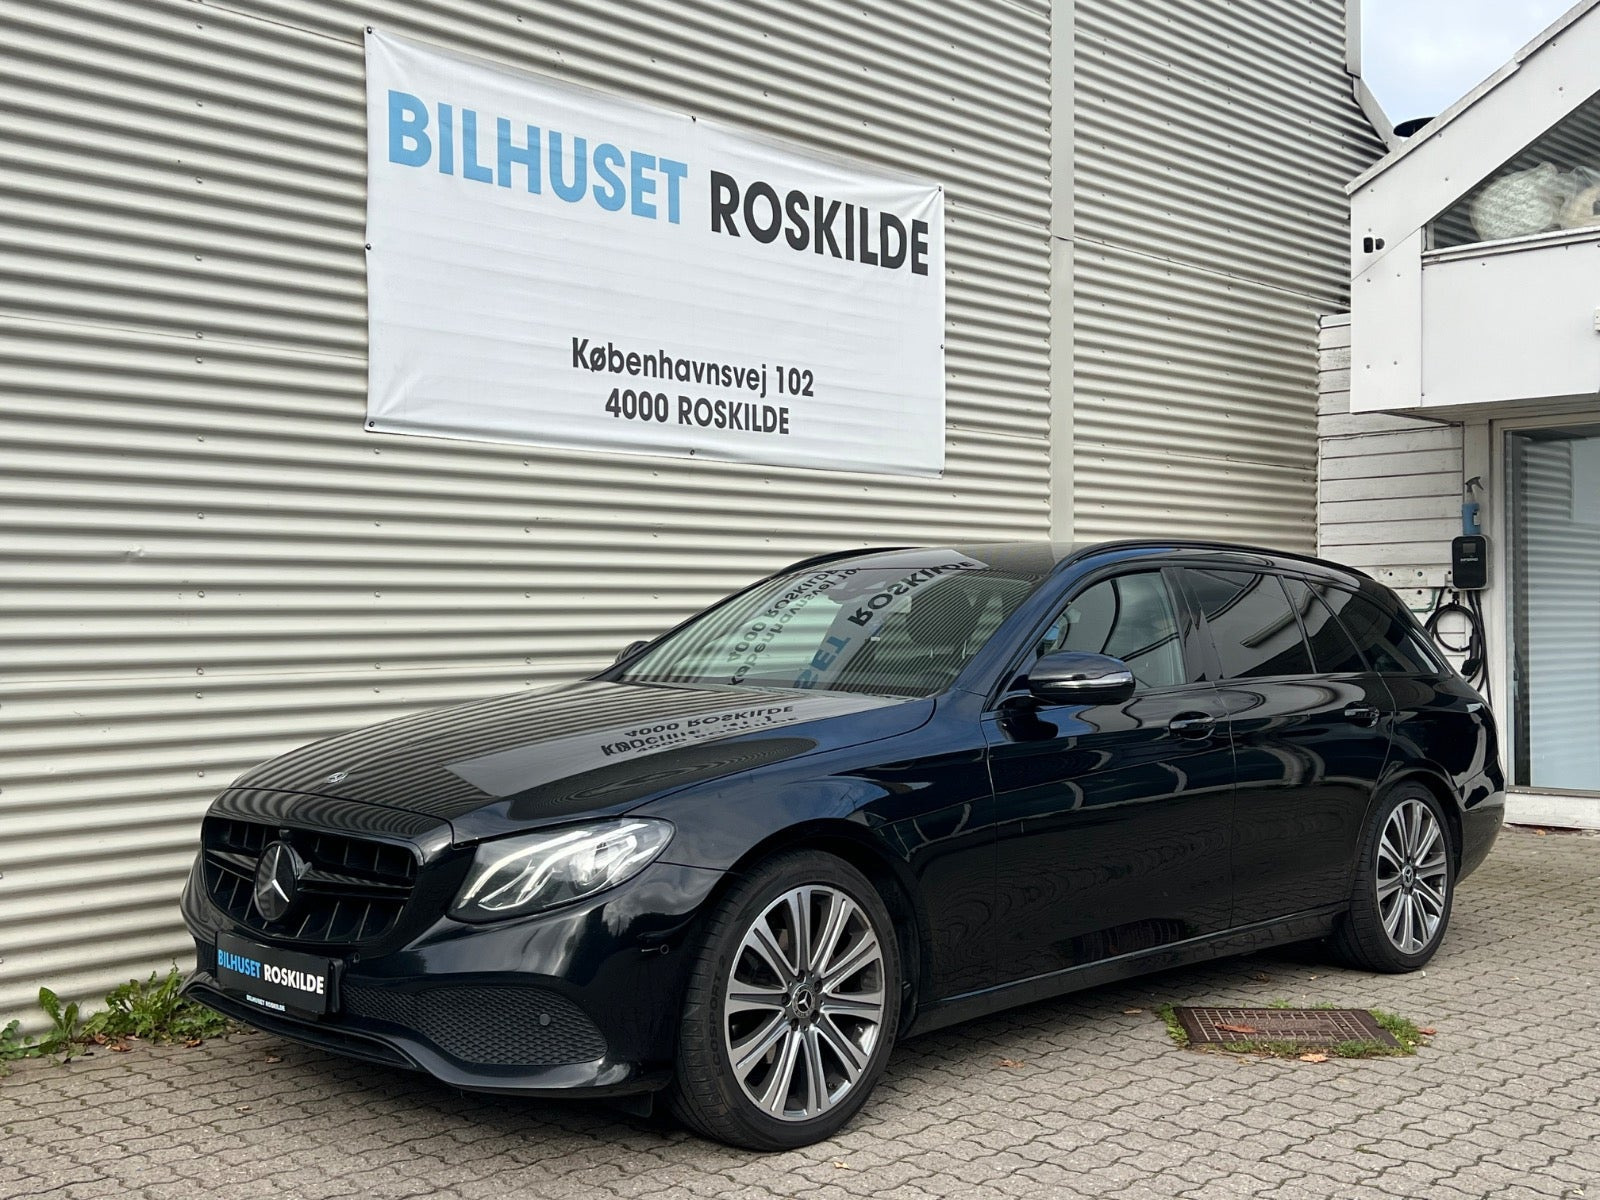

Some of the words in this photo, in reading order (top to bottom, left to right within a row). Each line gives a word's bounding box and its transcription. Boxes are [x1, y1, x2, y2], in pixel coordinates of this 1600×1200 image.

[388, 90, 688, 225] BILHUSET
[711, 170, 930, 277] ROSKILDE
[572, 337, 767, 397] Københavnsvej
[776, 365, 814, 397] 102
[605, 388, 669, 423] 4000
[678, 399, 790, 435] ROSKILDE
[217, 949, 261, 979] BILHUSET
[263, 963, 325, 995] ROSKILDE
